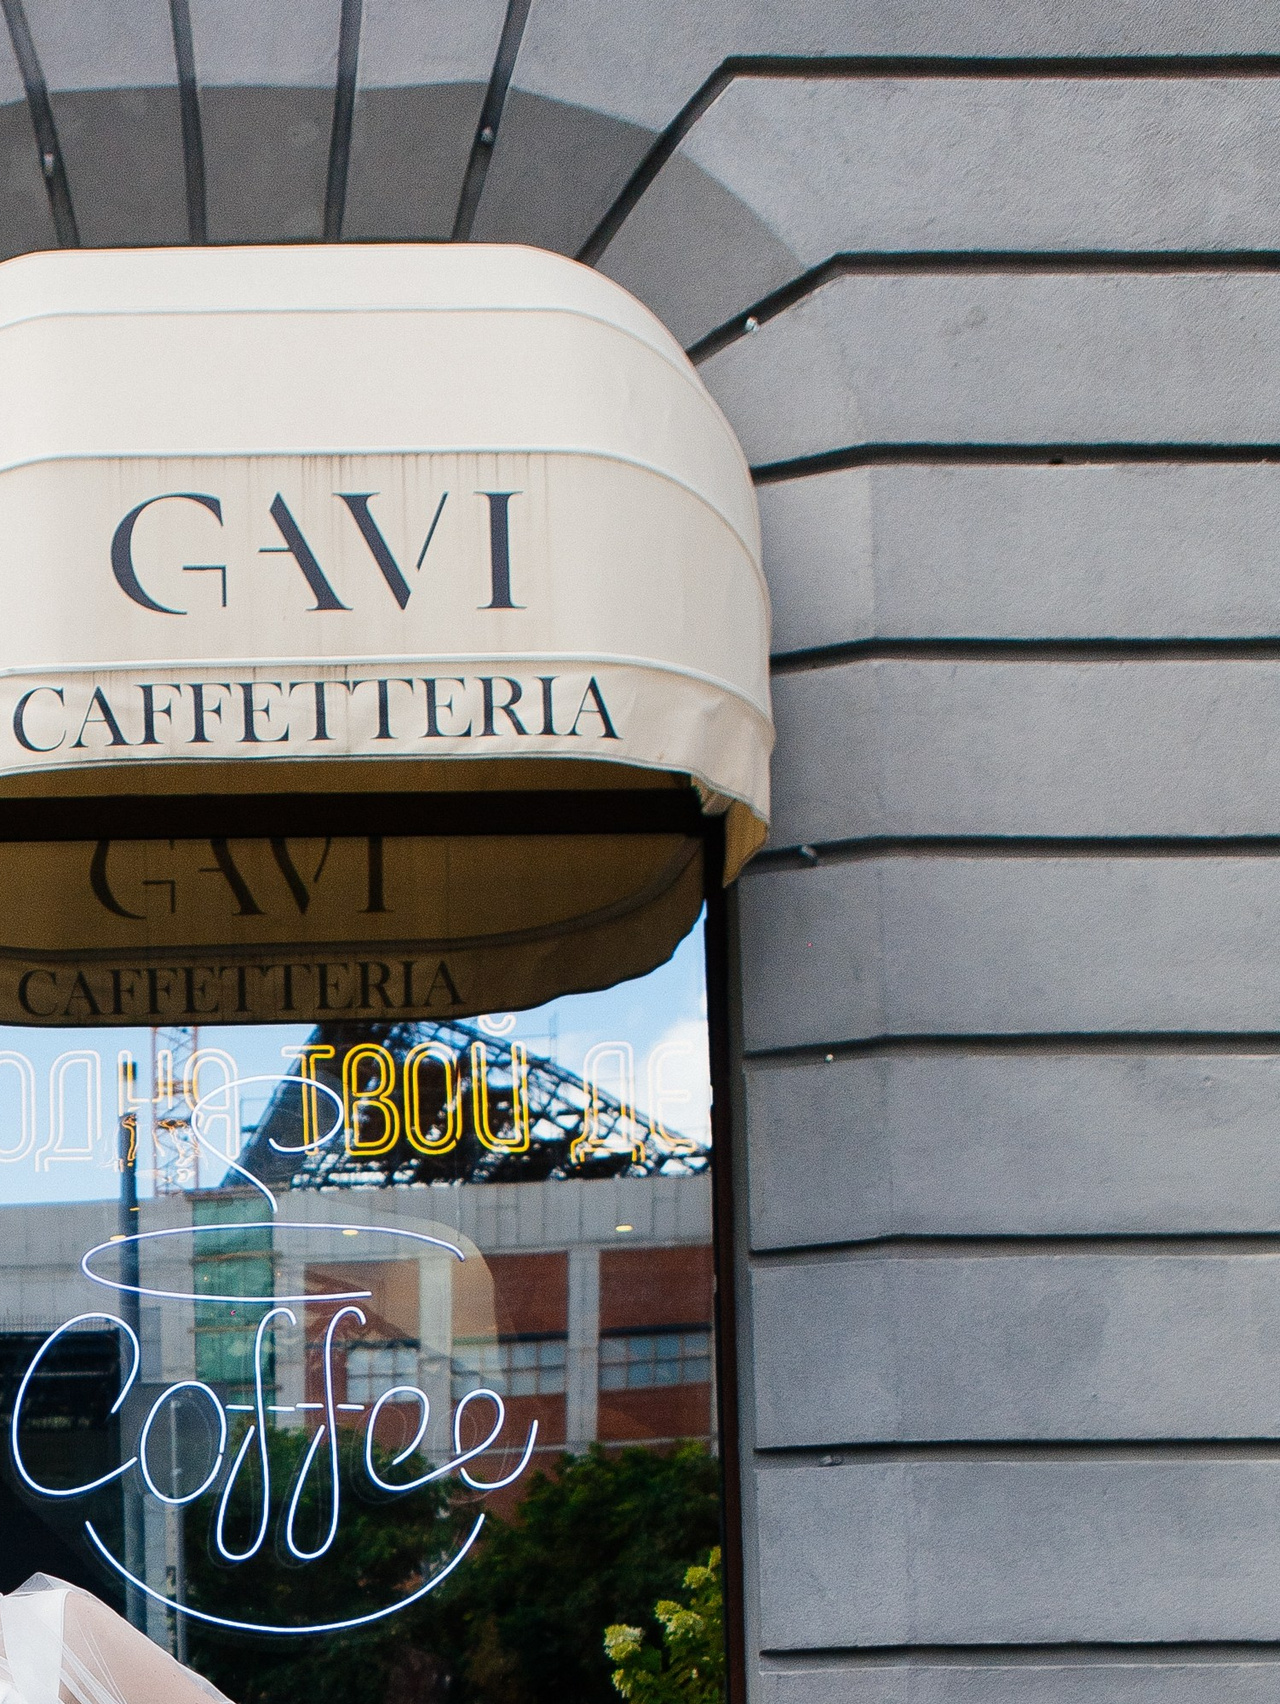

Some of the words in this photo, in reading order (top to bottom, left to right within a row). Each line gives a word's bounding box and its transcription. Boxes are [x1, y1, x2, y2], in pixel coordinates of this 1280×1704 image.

[111, 491, 527, 616] GAVI
[12, 675, 624, 753] CAFFETTERIA
[18, 960, 467, 1018] CAFFETTERIA
[11, 1306, 540, 1562] Coffee
